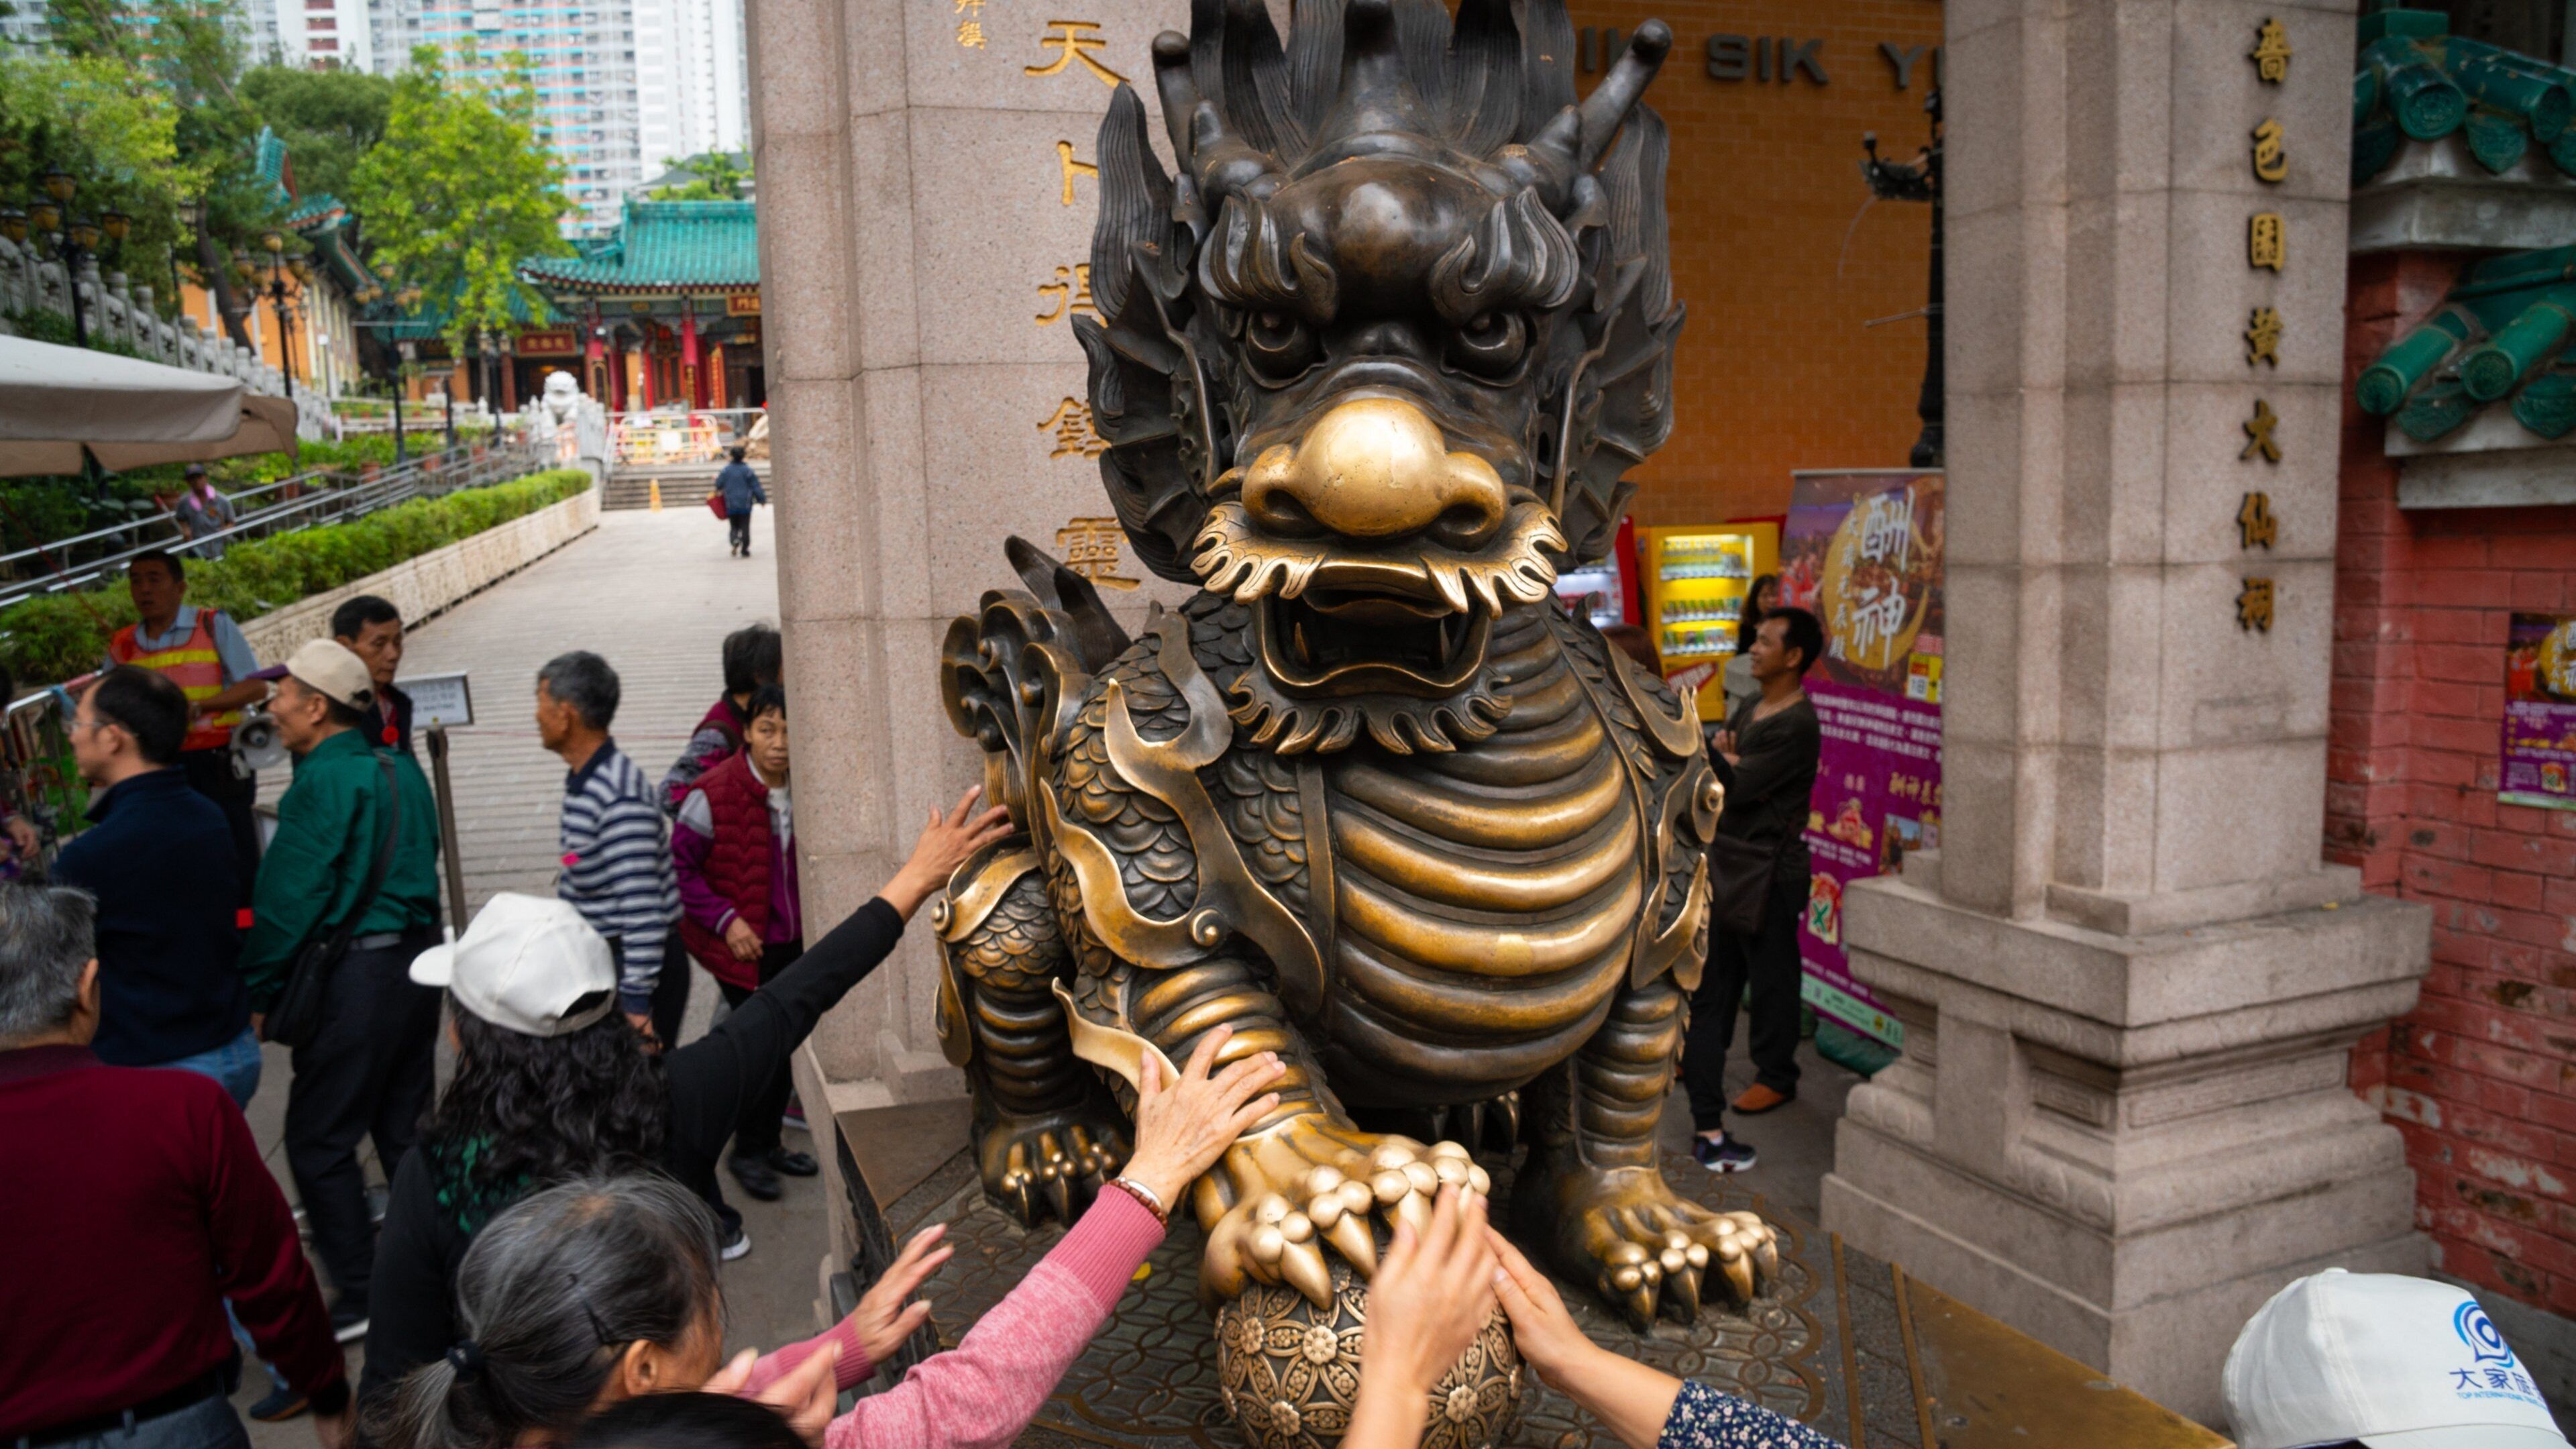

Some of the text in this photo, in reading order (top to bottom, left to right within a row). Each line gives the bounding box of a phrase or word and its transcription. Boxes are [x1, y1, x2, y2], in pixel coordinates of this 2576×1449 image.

[1707, 34, 1829, 85] SIK
[2237, 18, 2292, 631] 嗇色園黃大仙祠
[1851, 485, 1916, 670] 酬神
